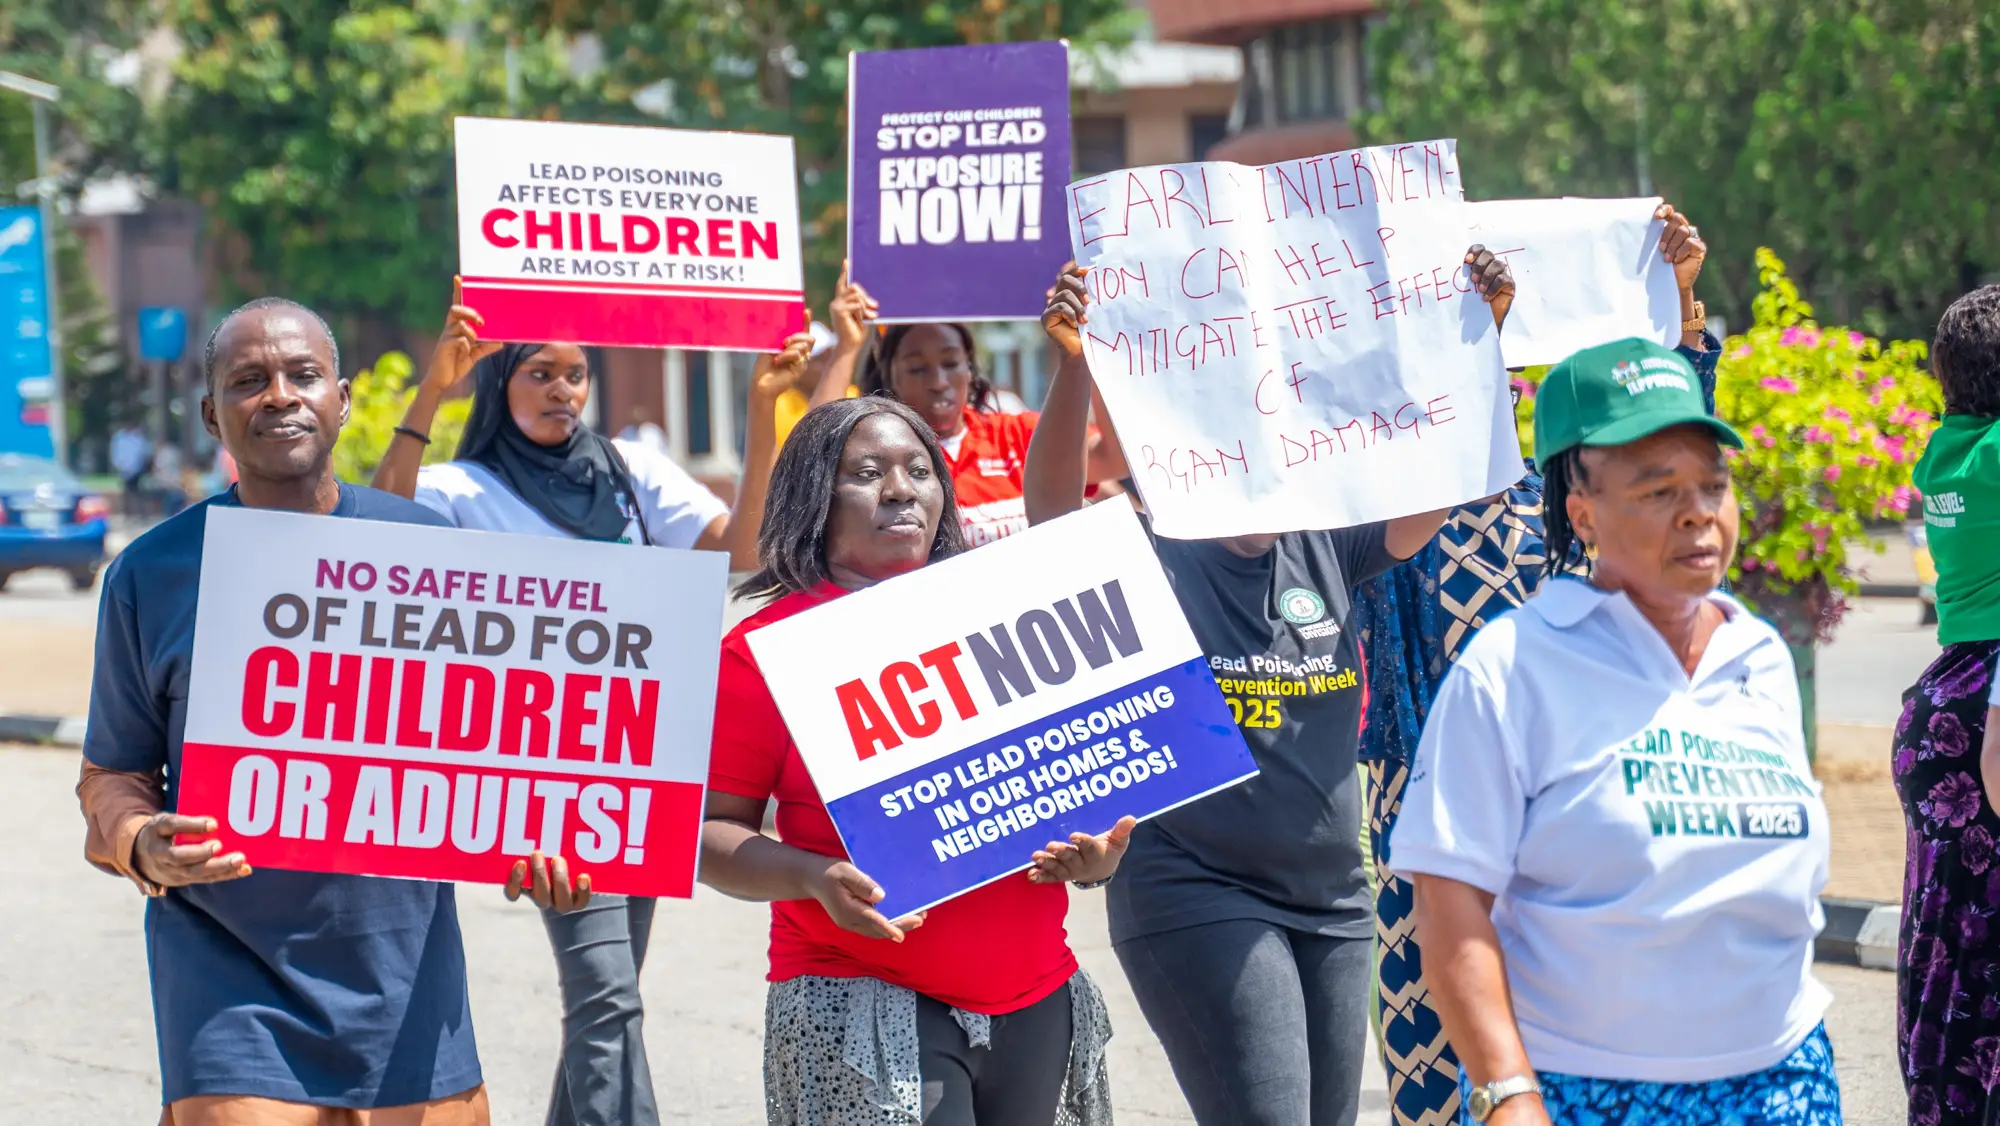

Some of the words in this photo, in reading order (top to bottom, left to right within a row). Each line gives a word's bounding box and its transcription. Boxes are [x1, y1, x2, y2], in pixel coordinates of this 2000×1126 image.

[877, 124, 962, 151] STOP
[965, 120, 1047, 147] LEAD
[881, 112, 943, 126] PROTECT
[943, 109, 973, 123] OUR
[974, 106, 1042, 121] CHILDREN
[529, 163, 586, 181] LEAD
[592, 166, 723, 188] POISONING
[879, 151, 1043, 189] EXPOSURE
[498, 184, 613, 207] AFFECTS
[620, 190, 759, 214] EVERYONE
[879, 184, 1042, 245] NOW!
[1073, 167, 1240, 247] EARL
[481, 208, 779, 260] CHILDREN
[1275, 227, 1395, 286] HELP
[521, 256, 566, 274] ARE
[572, 259, 640, 278] MOST
[647, 262, 677, 279] AT
[683, 263, 745, 282] RISK!
[1087, 311, 1269, 376] MITIGATE
[1274, 296, 1347, 339] THE
[1366, 266, 1480, 320] EFFEC
[1141, 440, 1249, 493] RGAN
[1280, 394, 1456, 467] DAMAGE
[315, 558, 378, 591] NO
[387, 565, 487, 601] SAFE
[495, 574, 608, 613] LEVEL
[263, 593, 347, 642] OF
[359, 601, 516, 656] LEAD
[529, 615, 652, 670] FOR
[1301, 623, 1341, 640] DIVISION
[835, 640, 979, 761] ACT
[965, 579, 1143, 707] NOW
[1208, 656, 1247, 673] ead
[1215, 676, 1307, 696] revention
[1309, 668, 1358, 695] Week
[241, 645, 660, 767] CHILDREN
[1225, 697, 1283, 729] 025
[879, 771, 953, 817] STOP
[954, 745, 1025, 790] LEAD
[1025, 685, 1175, 760] POISONING
[930, 745, 1179, 863] NEIGHBORHOODS!
[933, 801, 968, 831] IN
[970, 777, 1032, 814] OUR
[1030, 740, 1127, 792] HOMES
[1129, 728, 1152, 752] &
[1621, 758, 1815, 798] PREVENTION
[227, 754, 331, 841] OR
[343, 765, 652, 866] ADULTS!
[1642, 800, 1737, 837] WEEK
[1746, 804, 1803, 835] 2025
